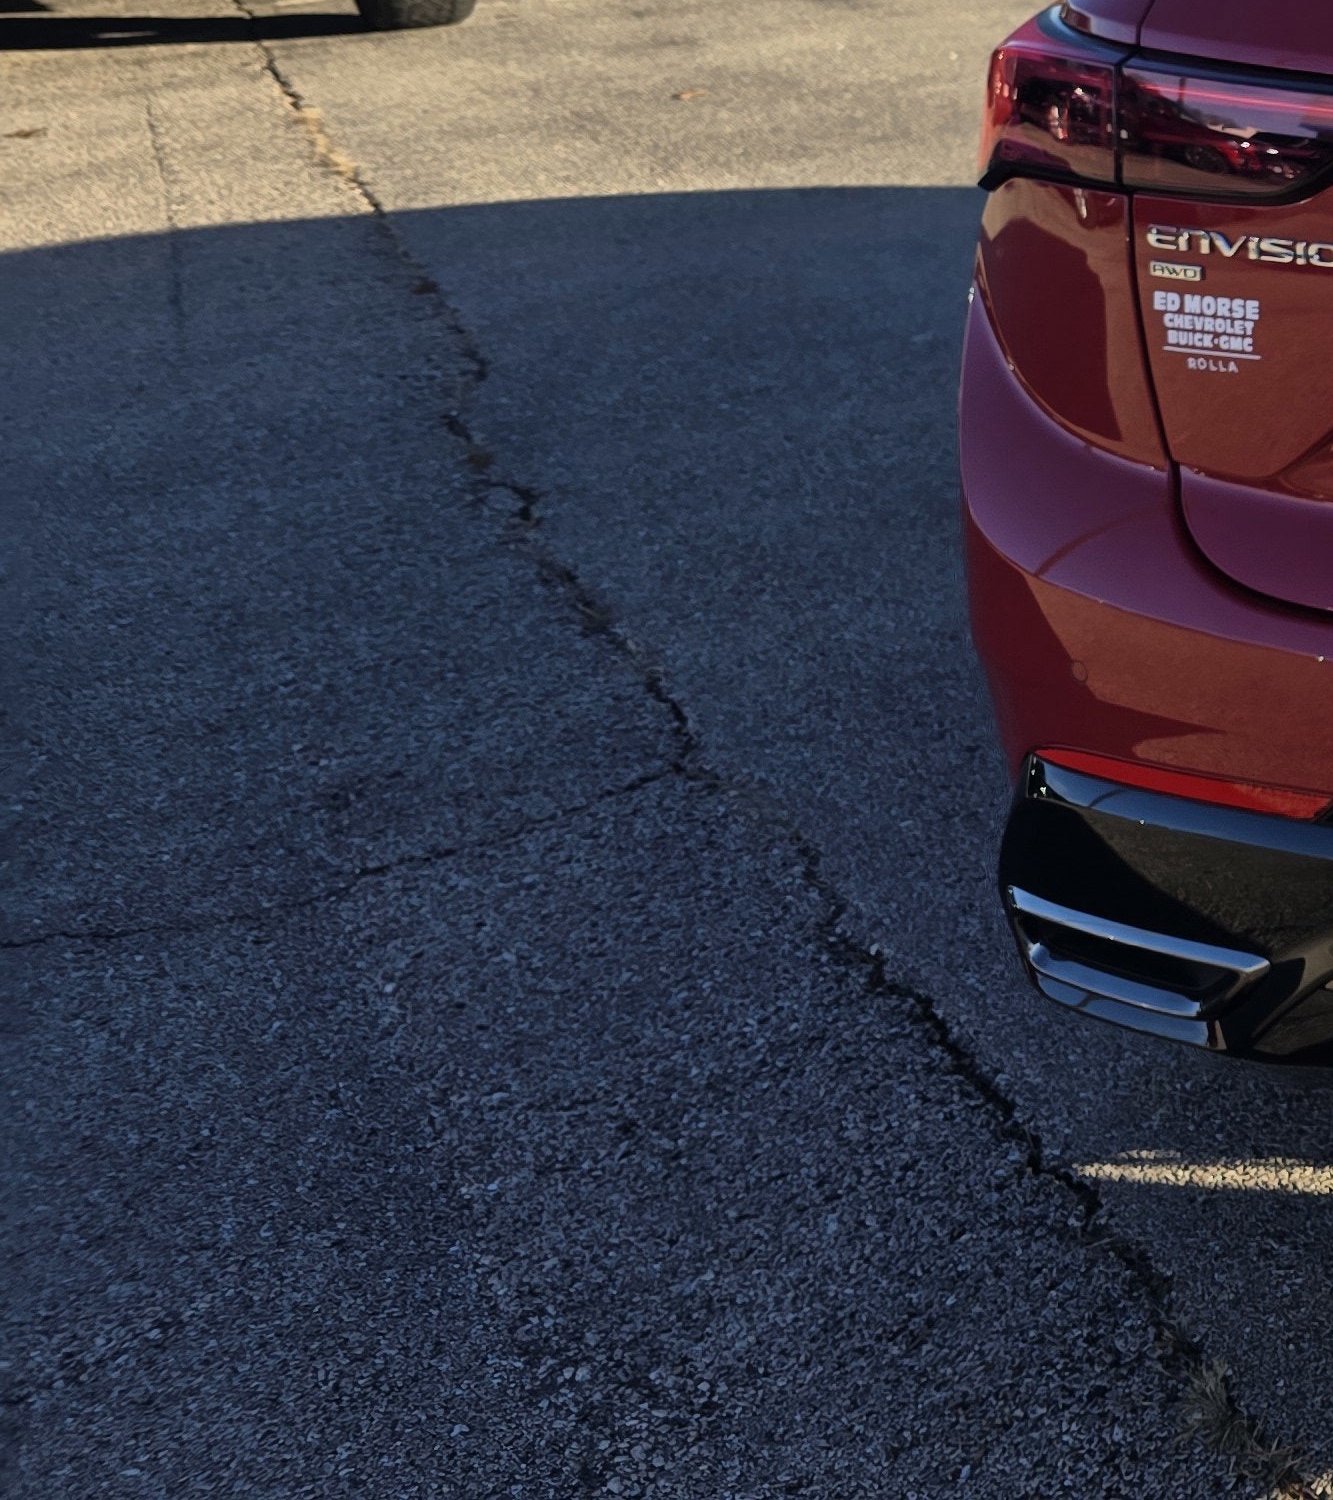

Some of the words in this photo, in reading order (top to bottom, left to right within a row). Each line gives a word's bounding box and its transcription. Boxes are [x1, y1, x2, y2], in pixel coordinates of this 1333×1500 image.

[1151, 263, 1200, 280] AWD
[1153, 290, 1181, 312] ED
[1183, 293, 1260, 320] MORSE
[1163, 313, 1255, 336] CHEVROLET
[1186, 357, 1239, 373] ROLLA
